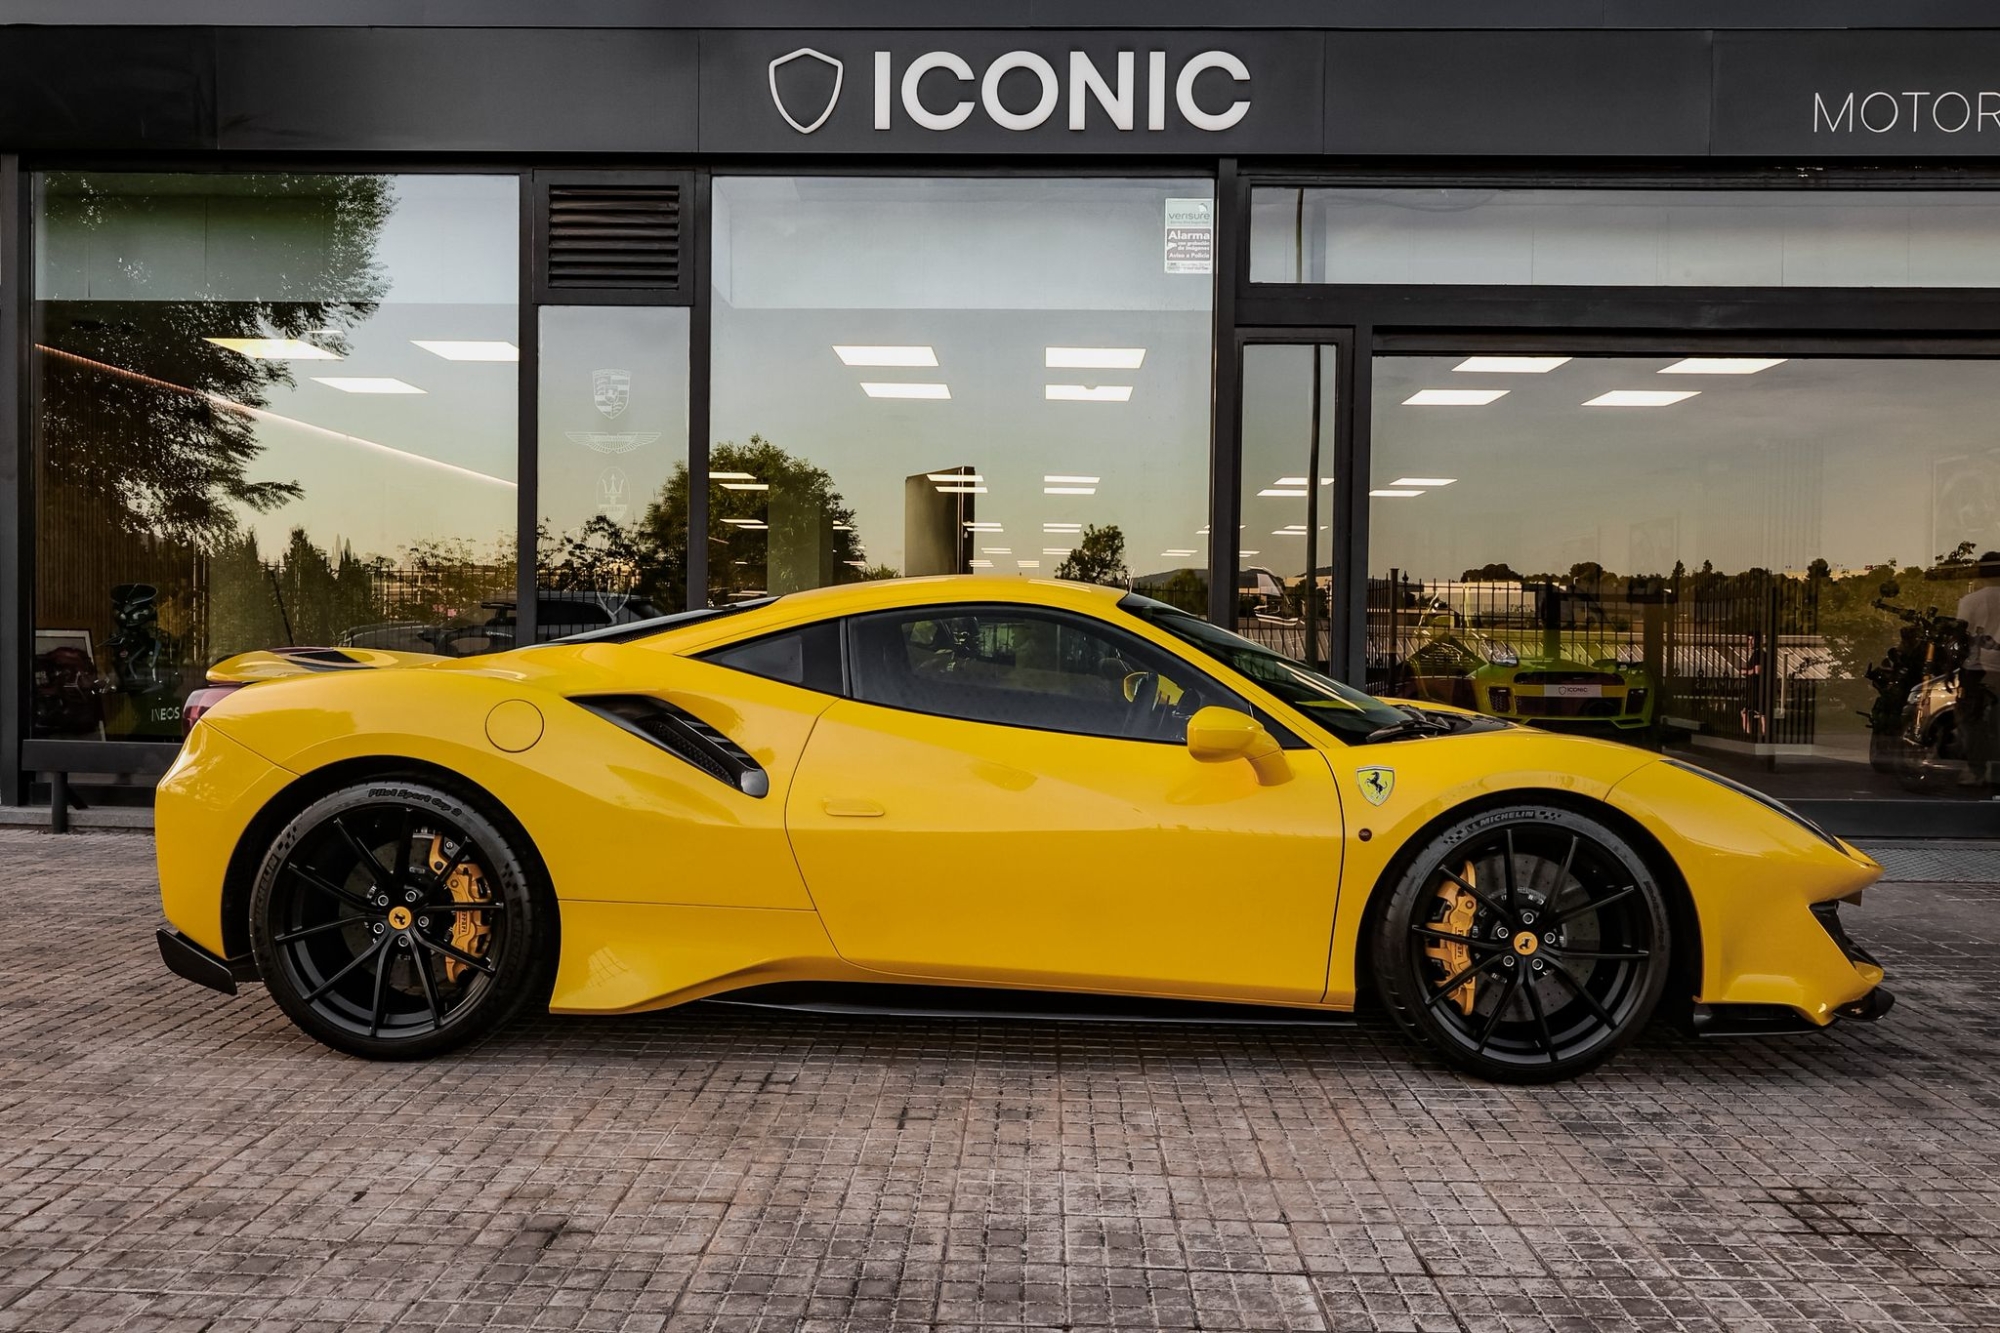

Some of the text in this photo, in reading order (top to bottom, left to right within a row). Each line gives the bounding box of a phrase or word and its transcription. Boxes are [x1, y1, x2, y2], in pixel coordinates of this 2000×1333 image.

[874, 50, 1252, 132] ICONIC
[1813, 91, 2000, 133] MOTOR
[1168, 212, 1211, 220] verisure
[1168, 230, 1210, 240] Alarma
[151, 706, 181, 722] INEOS
[1480, 810, 1535, 827] MICHELIN
